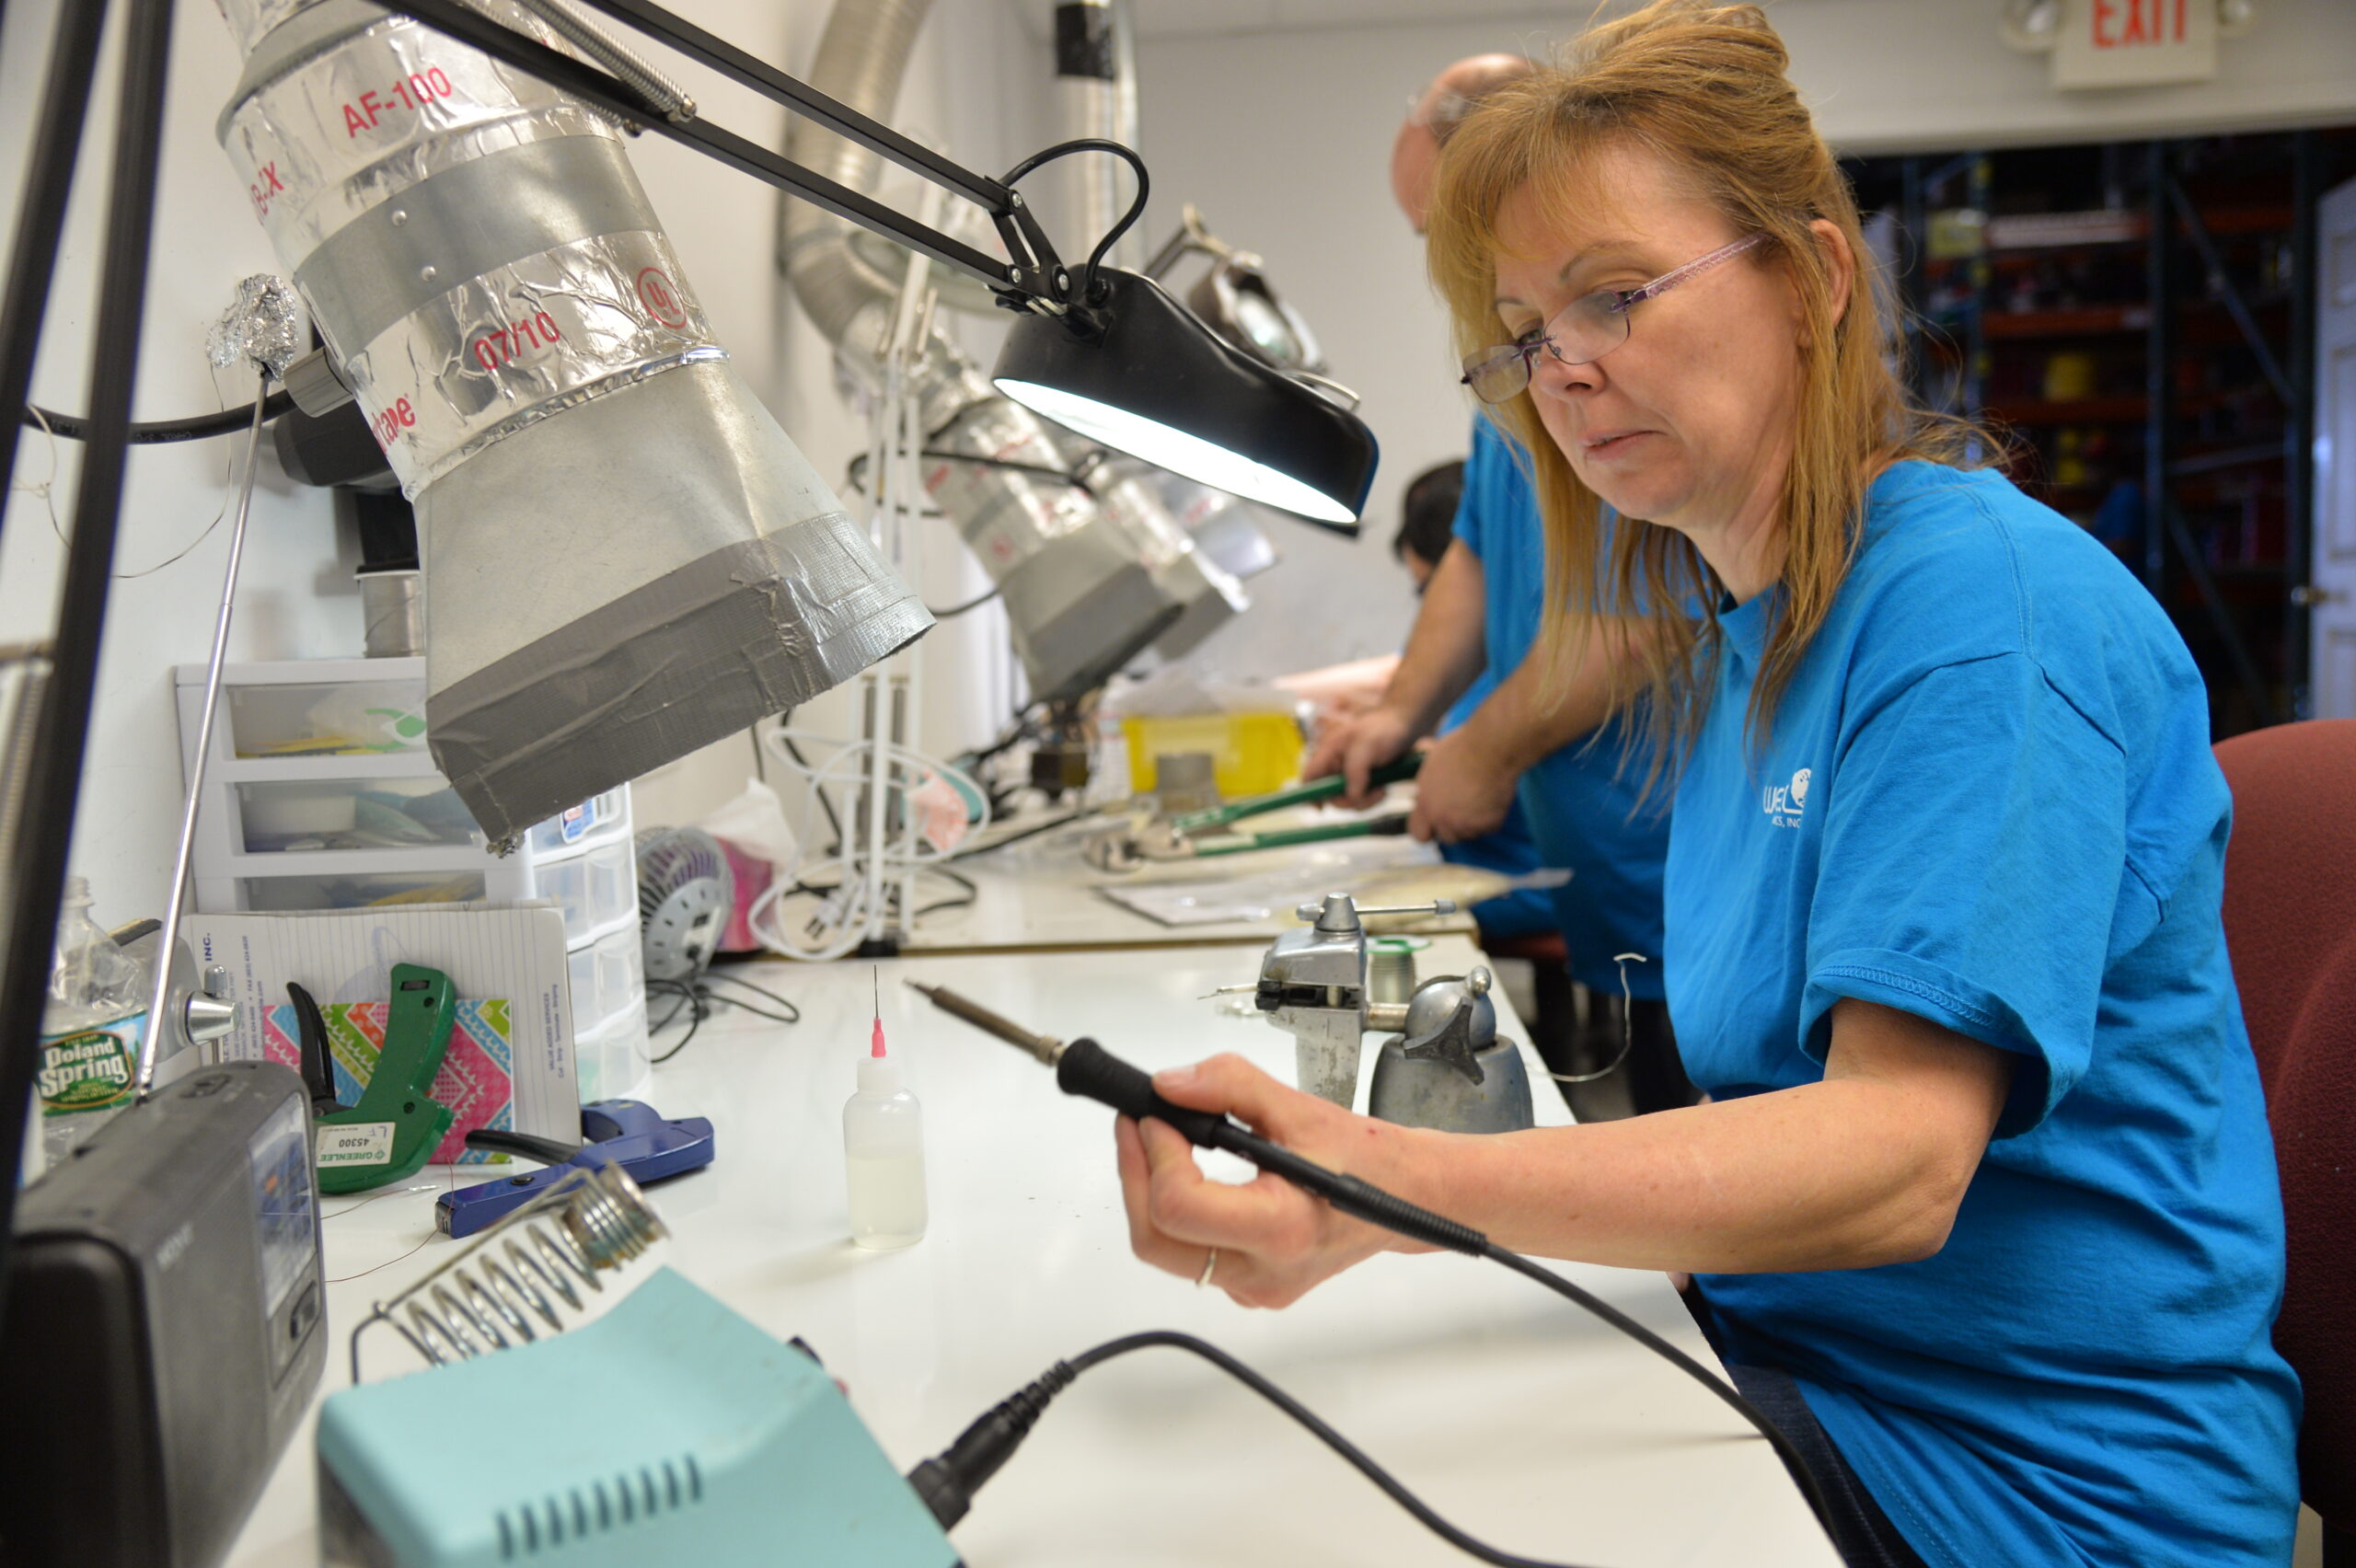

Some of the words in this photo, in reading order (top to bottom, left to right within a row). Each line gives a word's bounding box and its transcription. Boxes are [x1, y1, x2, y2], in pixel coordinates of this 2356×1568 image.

[2092, 0, 2188, 48] EXIT
[342, 66, 452, 139] AF-100
[474, 311, 560, 370] 07/10
[203, 932, 213, 962] INC.
[39, 1055, 129, 1098] Spring
[320, 1151, 373, 1161] GREENLEE
[339, 1137, 370, 1147] 45300
